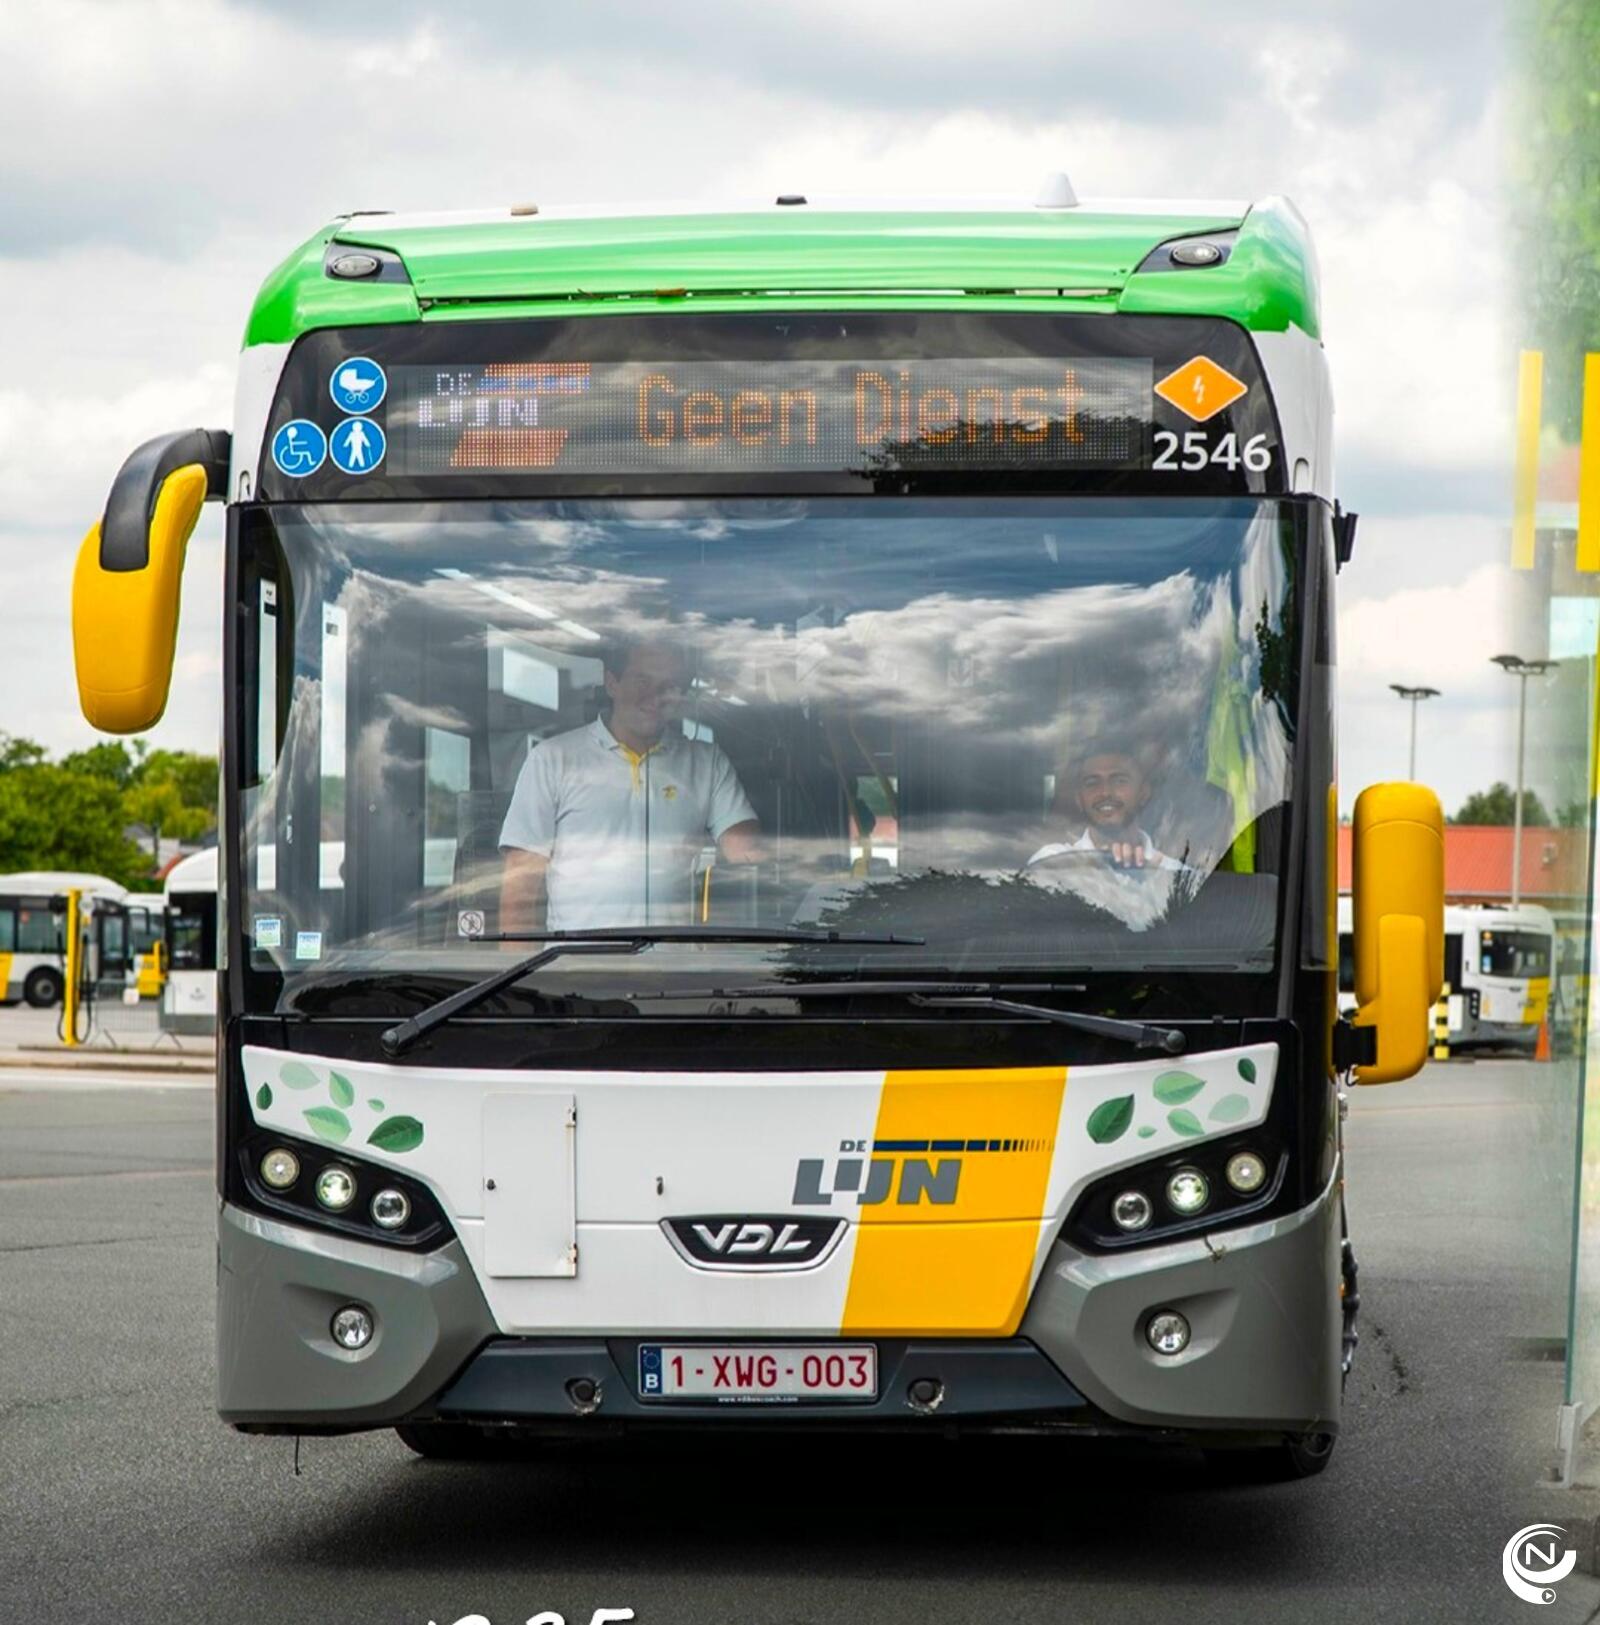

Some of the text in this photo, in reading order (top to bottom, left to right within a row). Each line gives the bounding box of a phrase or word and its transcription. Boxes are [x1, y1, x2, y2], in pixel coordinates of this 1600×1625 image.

[436, 372, 473, 396] DE
[638, 369, 1084, 447] Geen Dienst
[1152, 431, 1271, 471] 2546
[840, 1140, 867, 1152] DE
[692, 1224, 811, 1255] VDL
[645, 1373, 659, 1389] B
